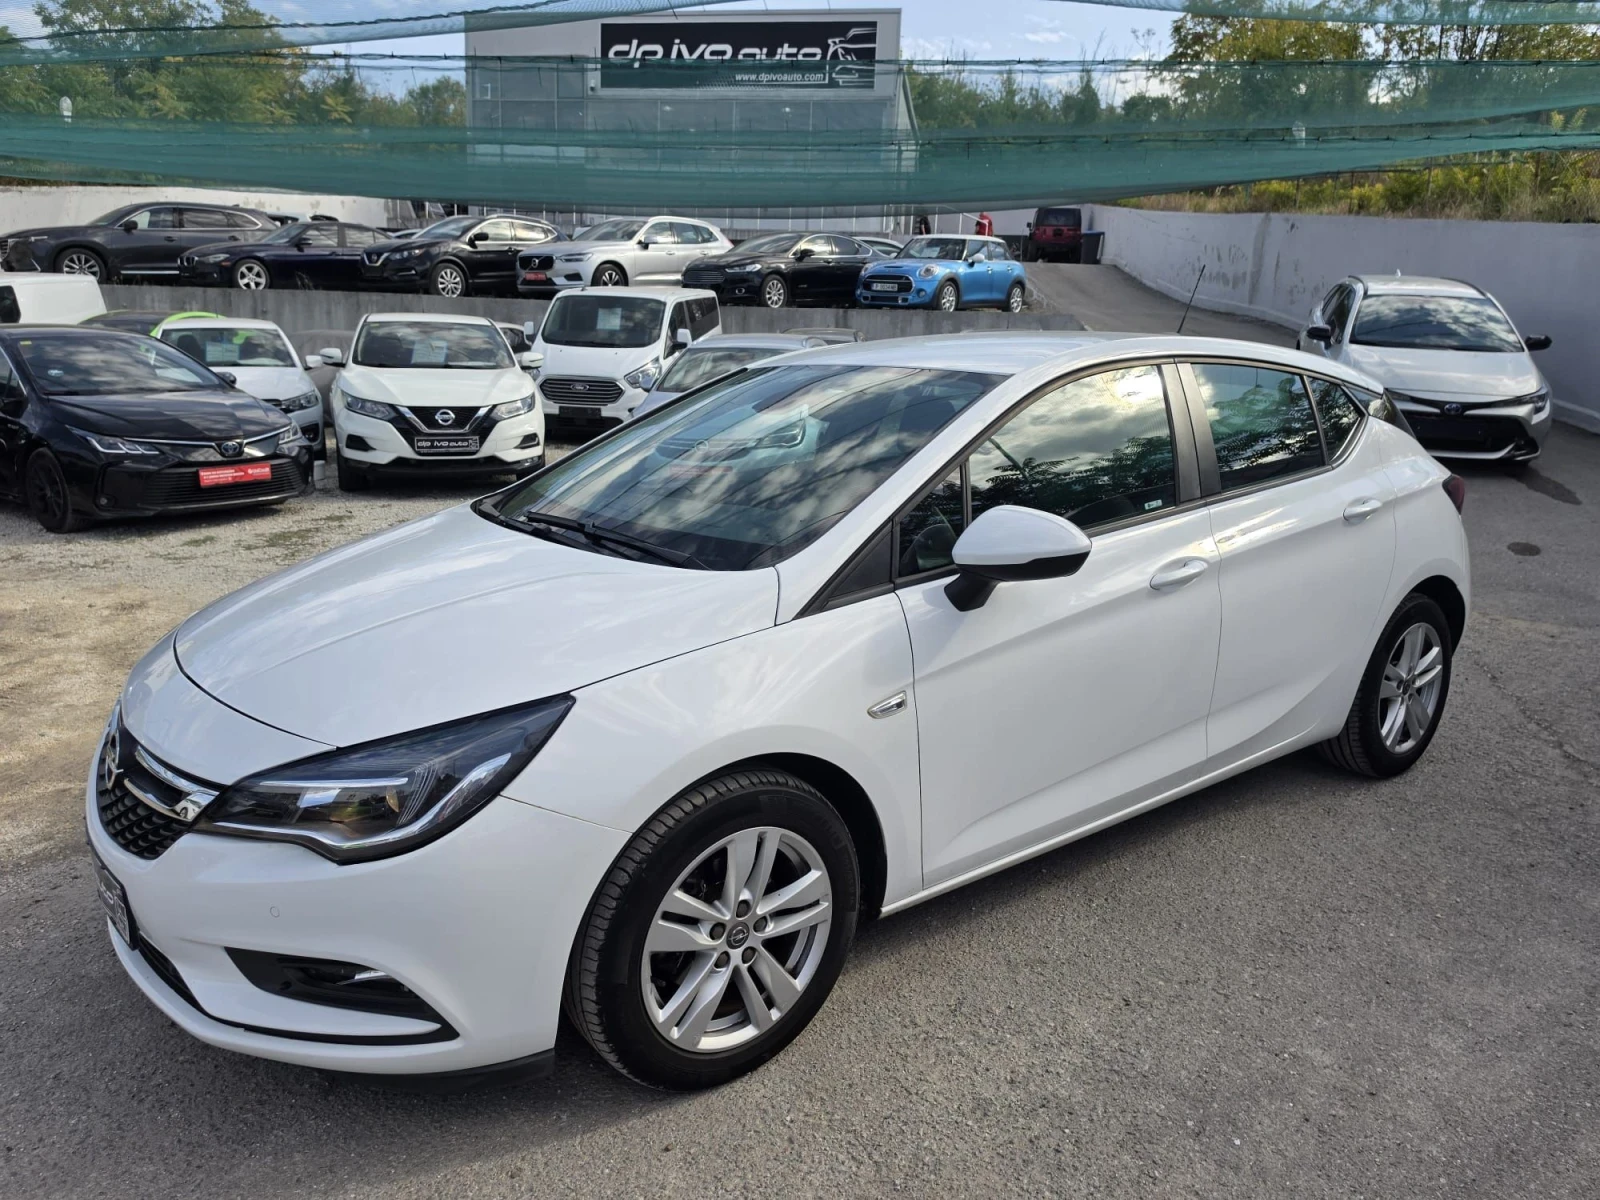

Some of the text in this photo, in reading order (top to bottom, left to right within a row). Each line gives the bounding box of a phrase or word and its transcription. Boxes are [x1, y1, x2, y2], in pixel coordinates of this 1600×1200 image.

[608, 39, 822, 68] dp ivo auto
